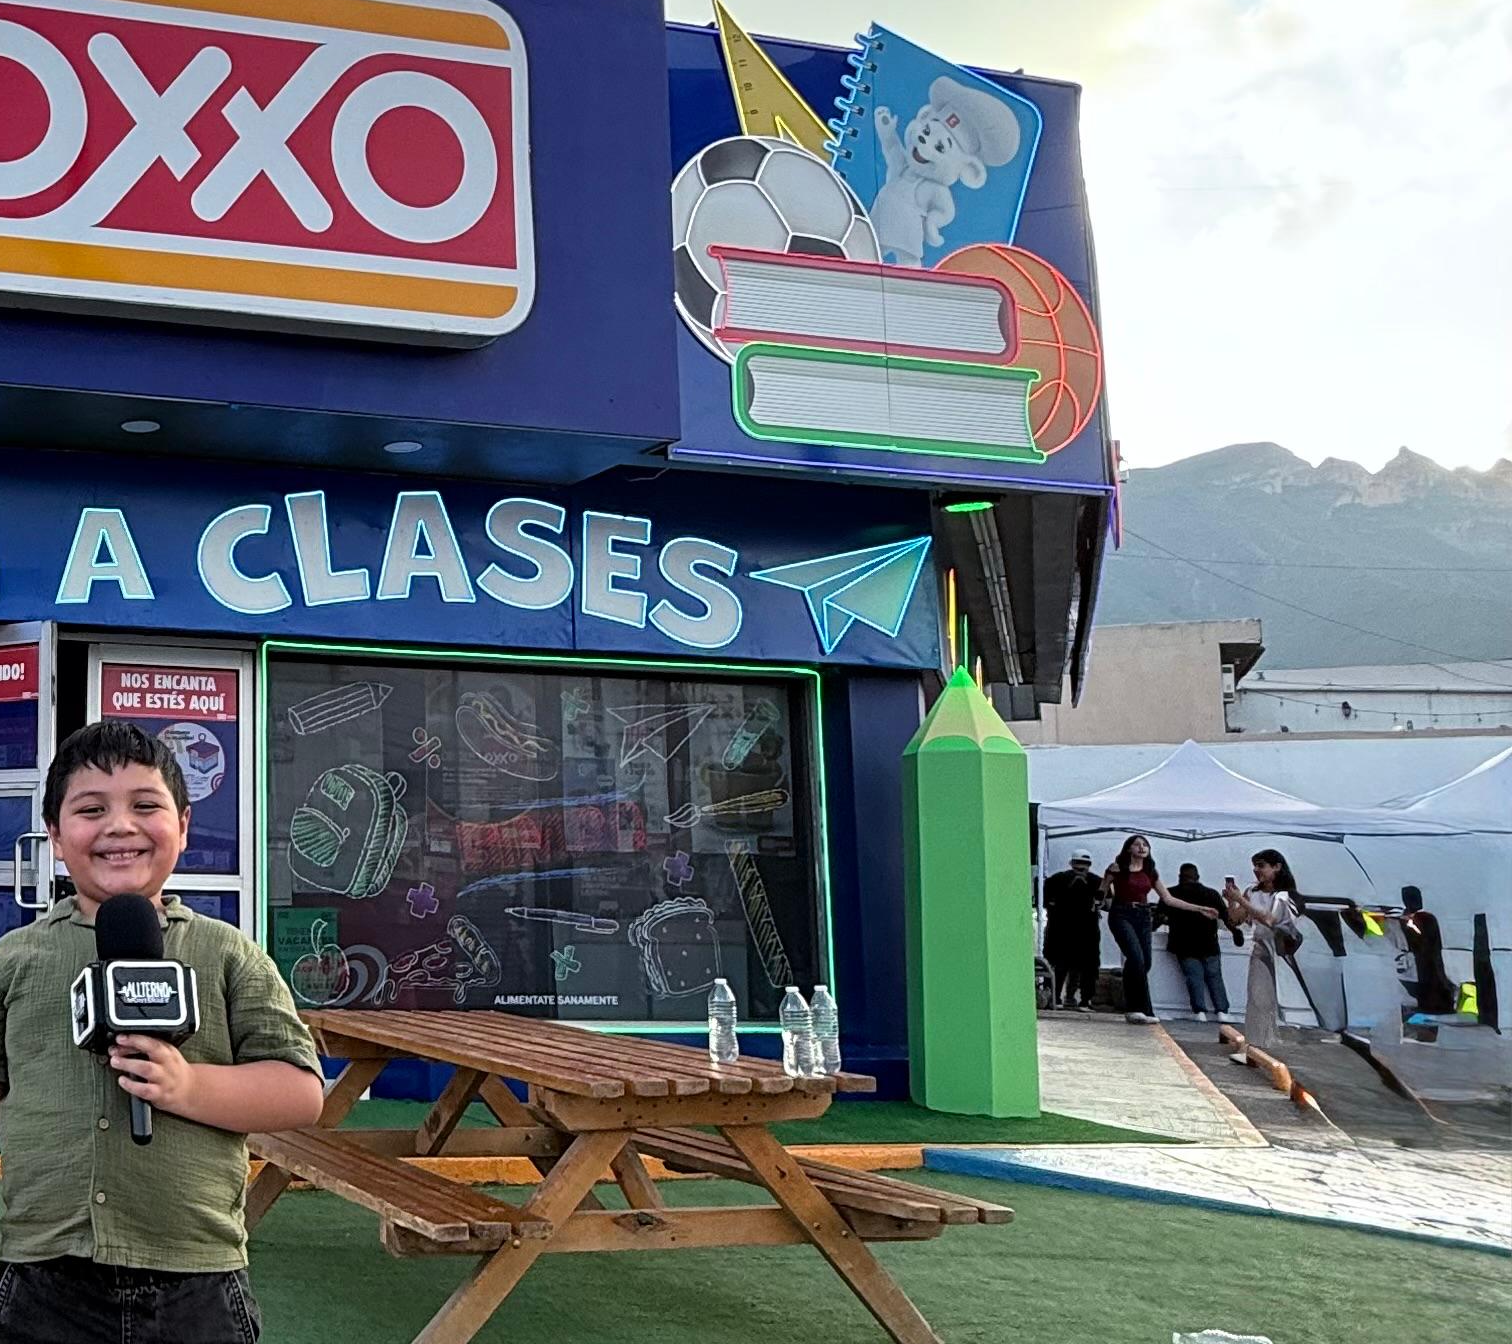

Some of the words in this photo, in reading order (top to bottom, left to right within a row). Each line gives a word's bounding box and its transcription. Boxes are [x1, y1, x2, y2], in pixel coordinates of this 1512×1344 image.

[56, 507, 155, 605] A
[197, 489, 744, 649] CLASES
[120, 672, 150, 689] NOS
[153, 673, 217, 692] ENCANTA
[112, 692, 142, 710] QUE
[145, 690, 186, 710] ESTÉS
[189, 692, 226, 714] AQUÍ
[493, 994, 555, 1006] ALIMENTATE
[557, 994, 619, 1006] SANAMENTE
